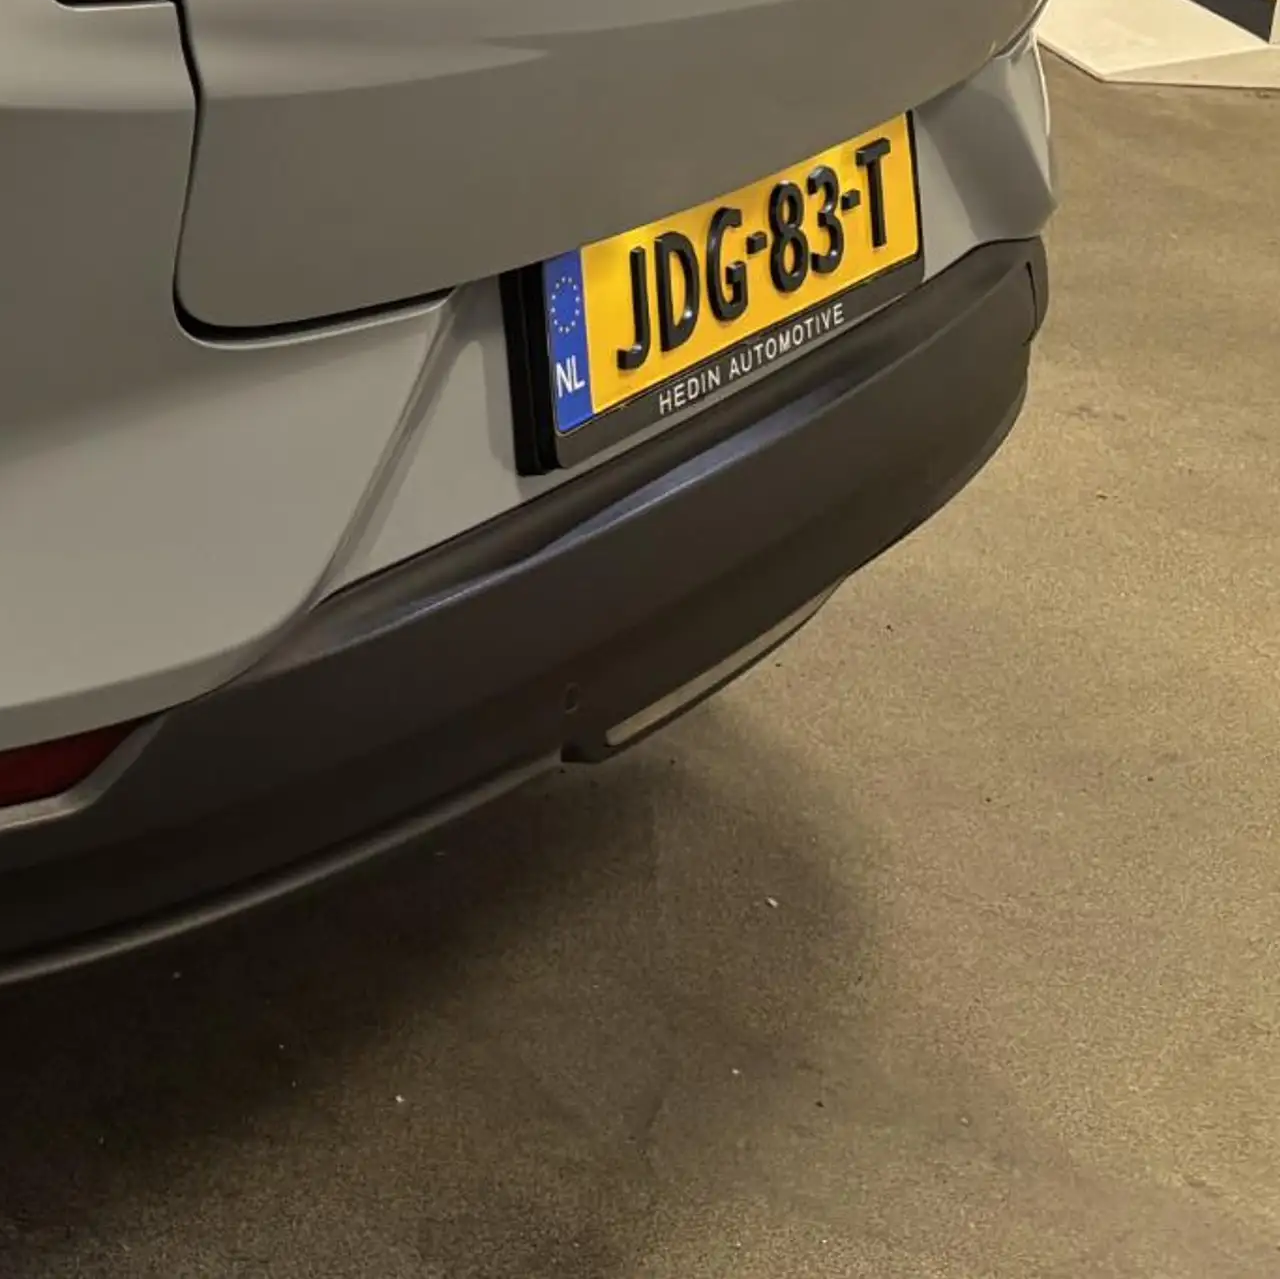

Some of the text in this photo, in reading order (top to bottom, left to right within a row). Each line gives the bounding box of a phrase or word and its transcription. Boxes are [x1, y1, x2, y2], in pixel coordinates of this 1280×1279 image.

[616, 137, 891, 370] JDG-83-T
[555, 355, 586, 399] NL
[658, 303, 845, 415] HEDIN AUTOMOTIVE
